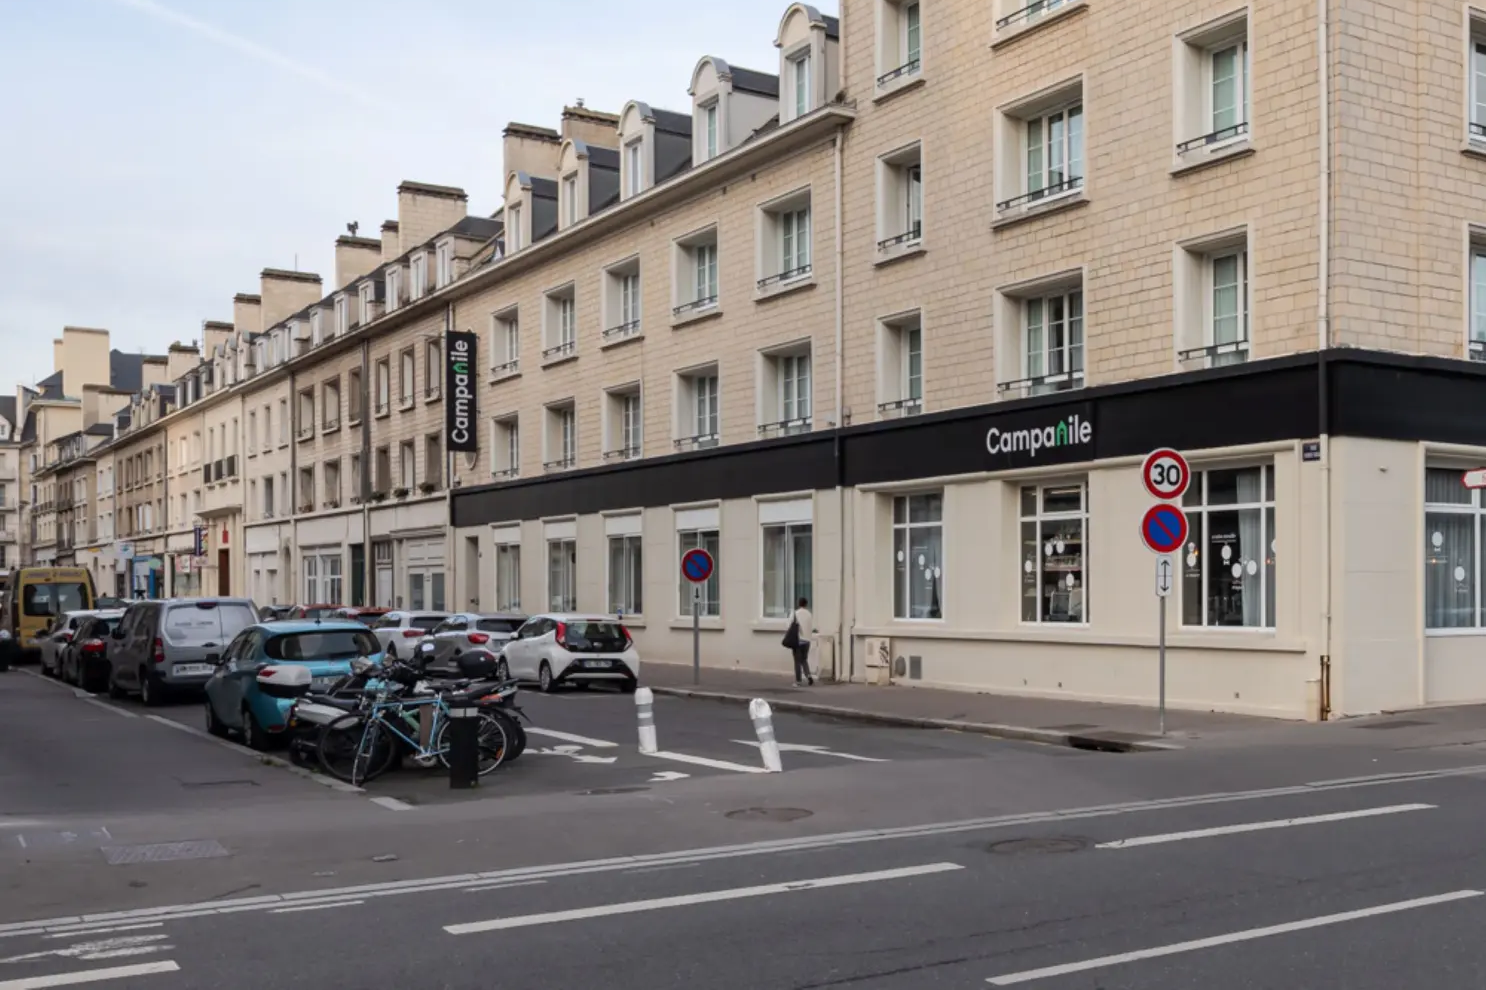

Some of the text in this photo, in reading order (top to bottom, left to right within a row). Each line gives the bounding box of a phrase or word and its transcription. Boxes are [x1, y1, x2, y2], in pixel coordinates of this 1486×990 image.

[450, 340, 473, 444] Campanile
[986, 413, 1092, 458] Campanile
[1153, 463, 1180, 486] 30
